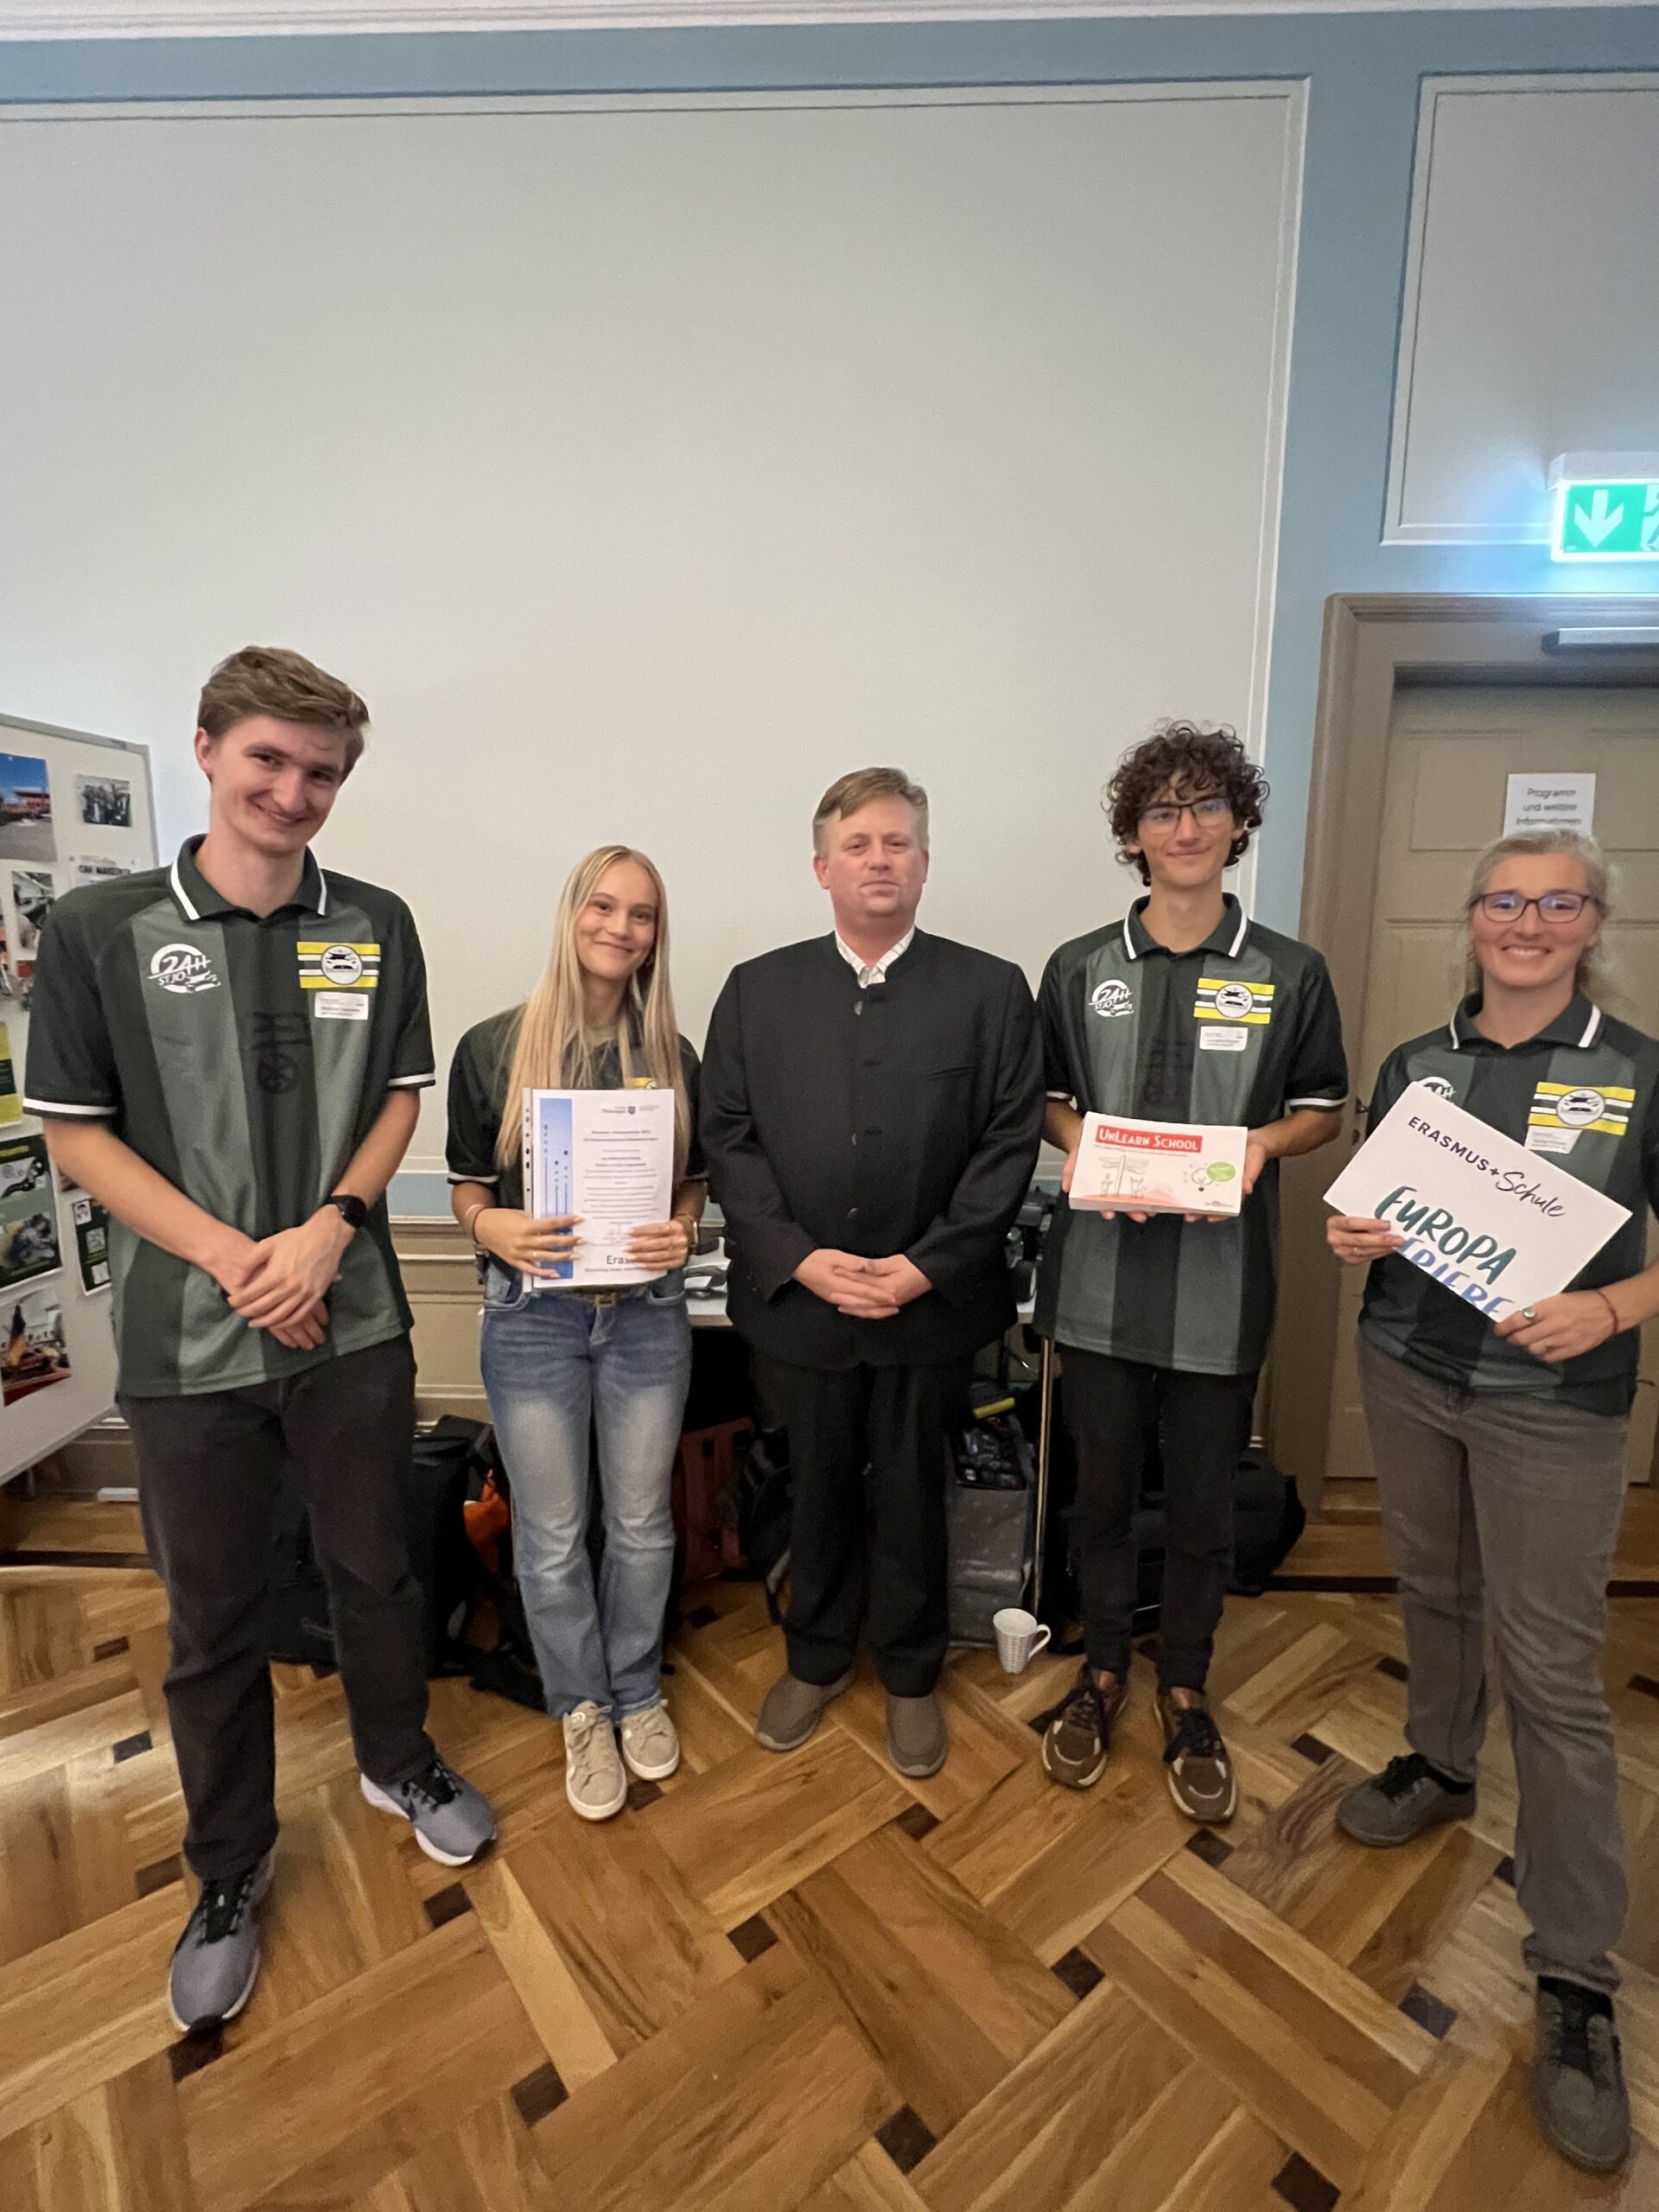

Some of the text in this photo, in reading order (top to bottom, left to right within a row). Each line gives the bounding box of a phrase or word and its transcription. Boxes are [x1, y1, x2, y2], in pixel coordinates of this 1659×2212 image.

[1527, 787, 1577, 799] Programm
[156, 954, 212, 976] 24H
[1495, 1171, 1566, 1217] Schule
